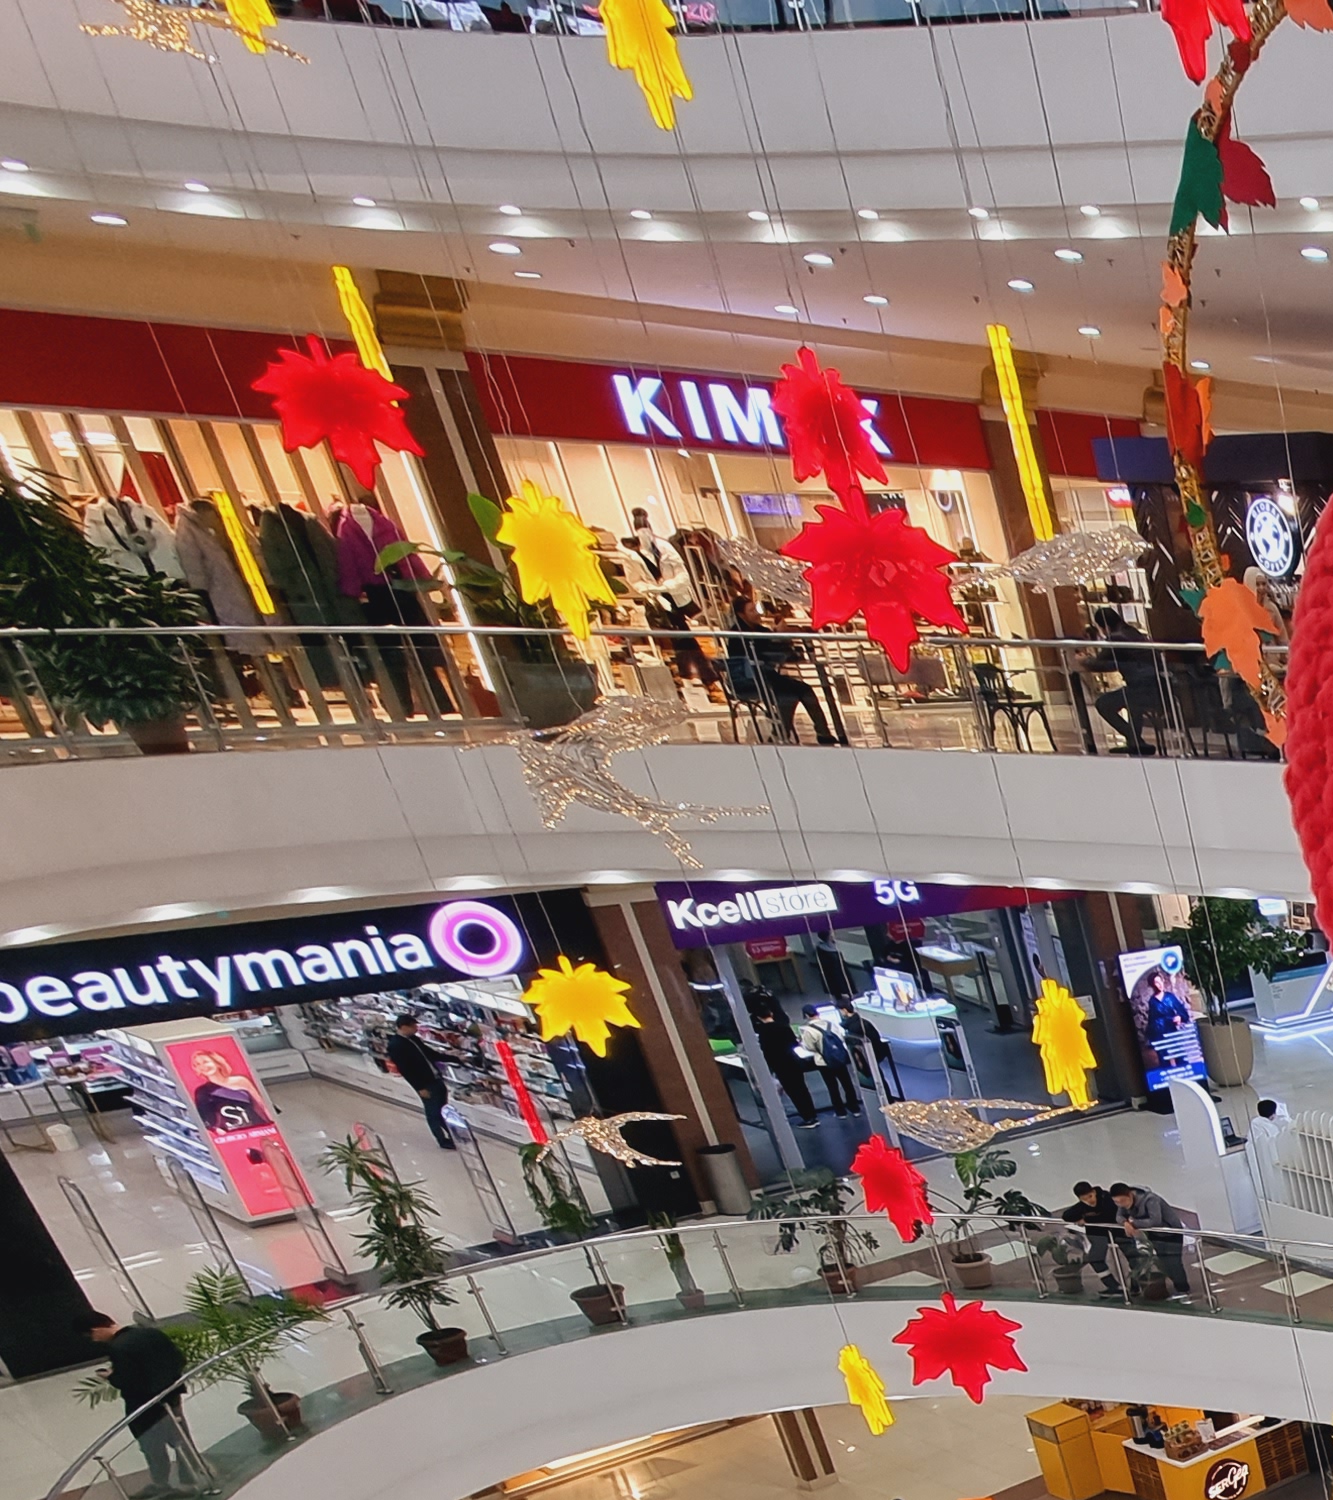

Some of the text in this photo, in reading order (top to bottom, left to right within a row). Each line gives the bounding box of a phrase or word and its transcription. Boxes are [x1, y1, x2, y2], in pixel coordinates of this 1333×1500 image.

[612, 374, 893, 454] KIM
[667, 890, 829, 930] Kcell store
[873, 880, 919, 905] 5G
